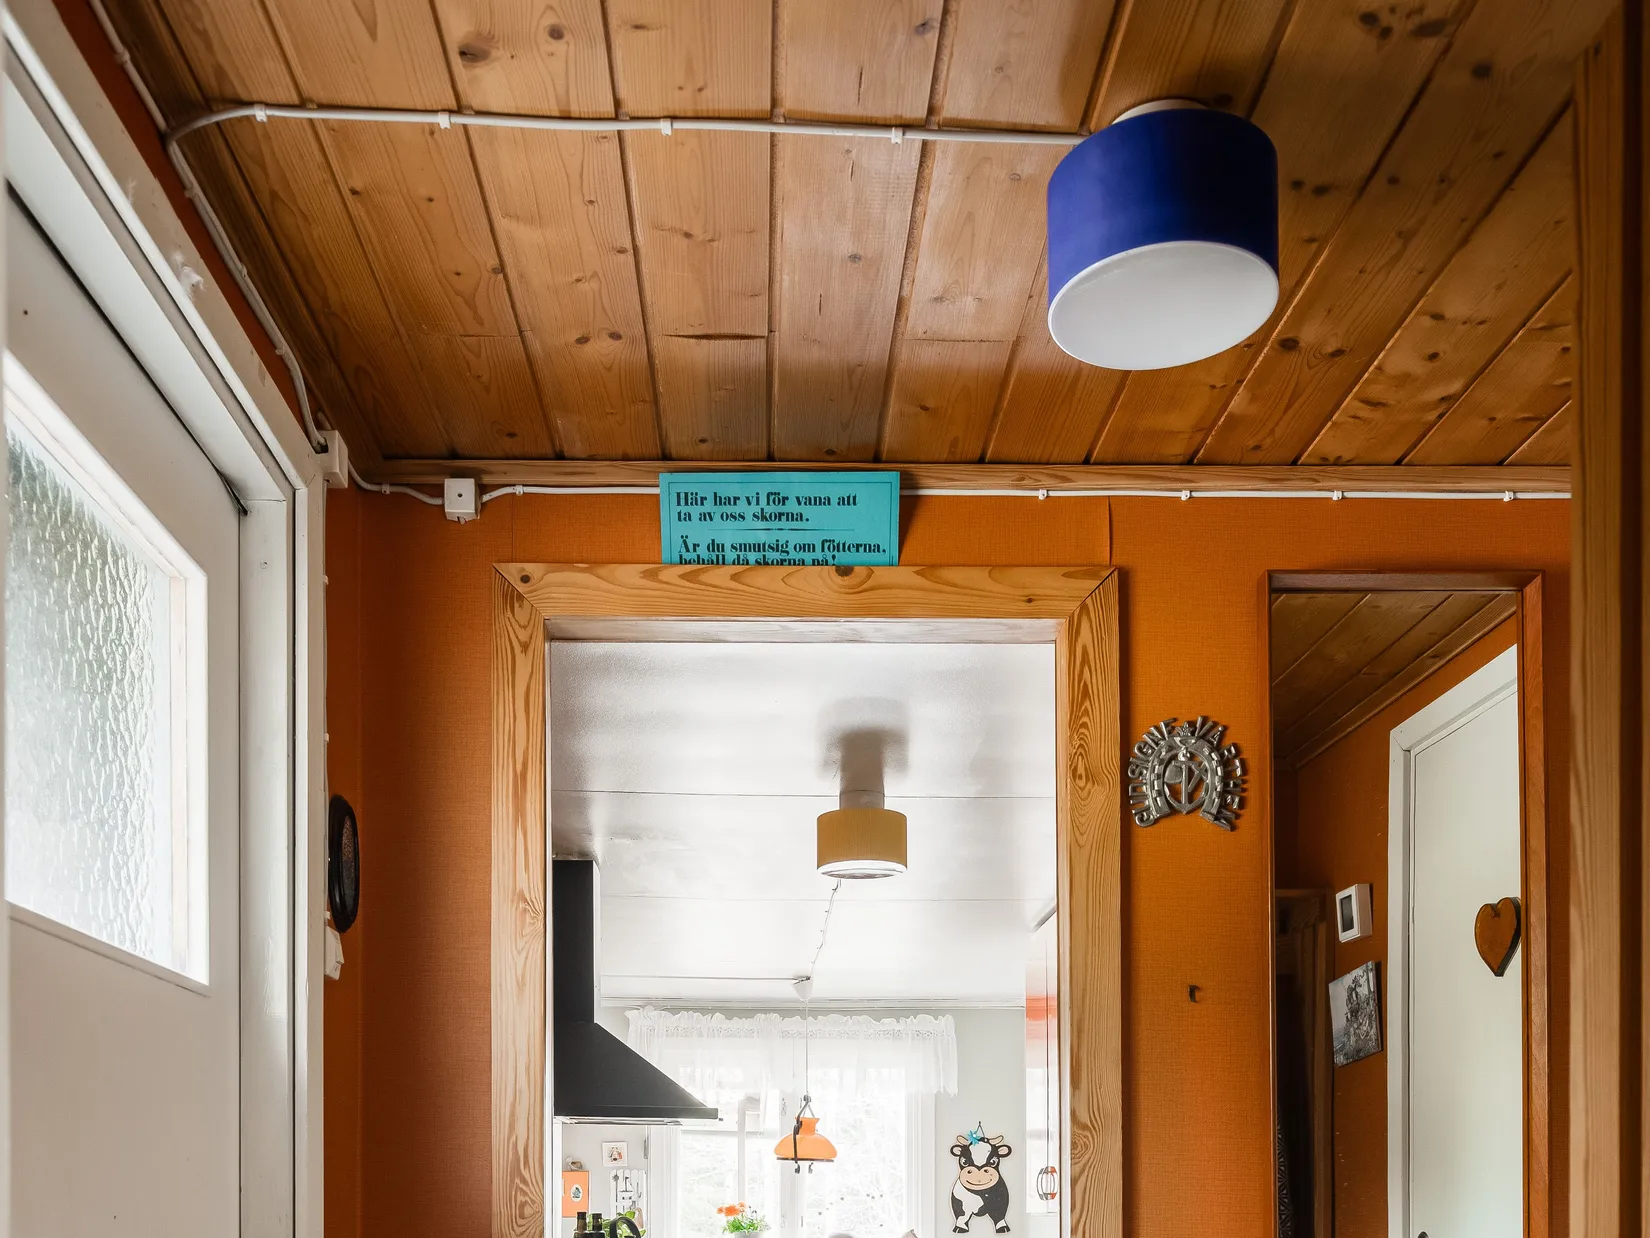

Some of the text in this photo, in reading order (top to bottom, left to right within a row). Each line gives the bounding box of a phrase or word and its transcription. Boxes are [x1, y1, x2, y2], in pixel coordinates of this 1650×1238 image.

[675, 491, 858, 507] Här har vi för vana att
[677, 507, 810, 523] ta av oss skorna.
[678, 534, 887, 556] Är du smutsig om fötterna,
